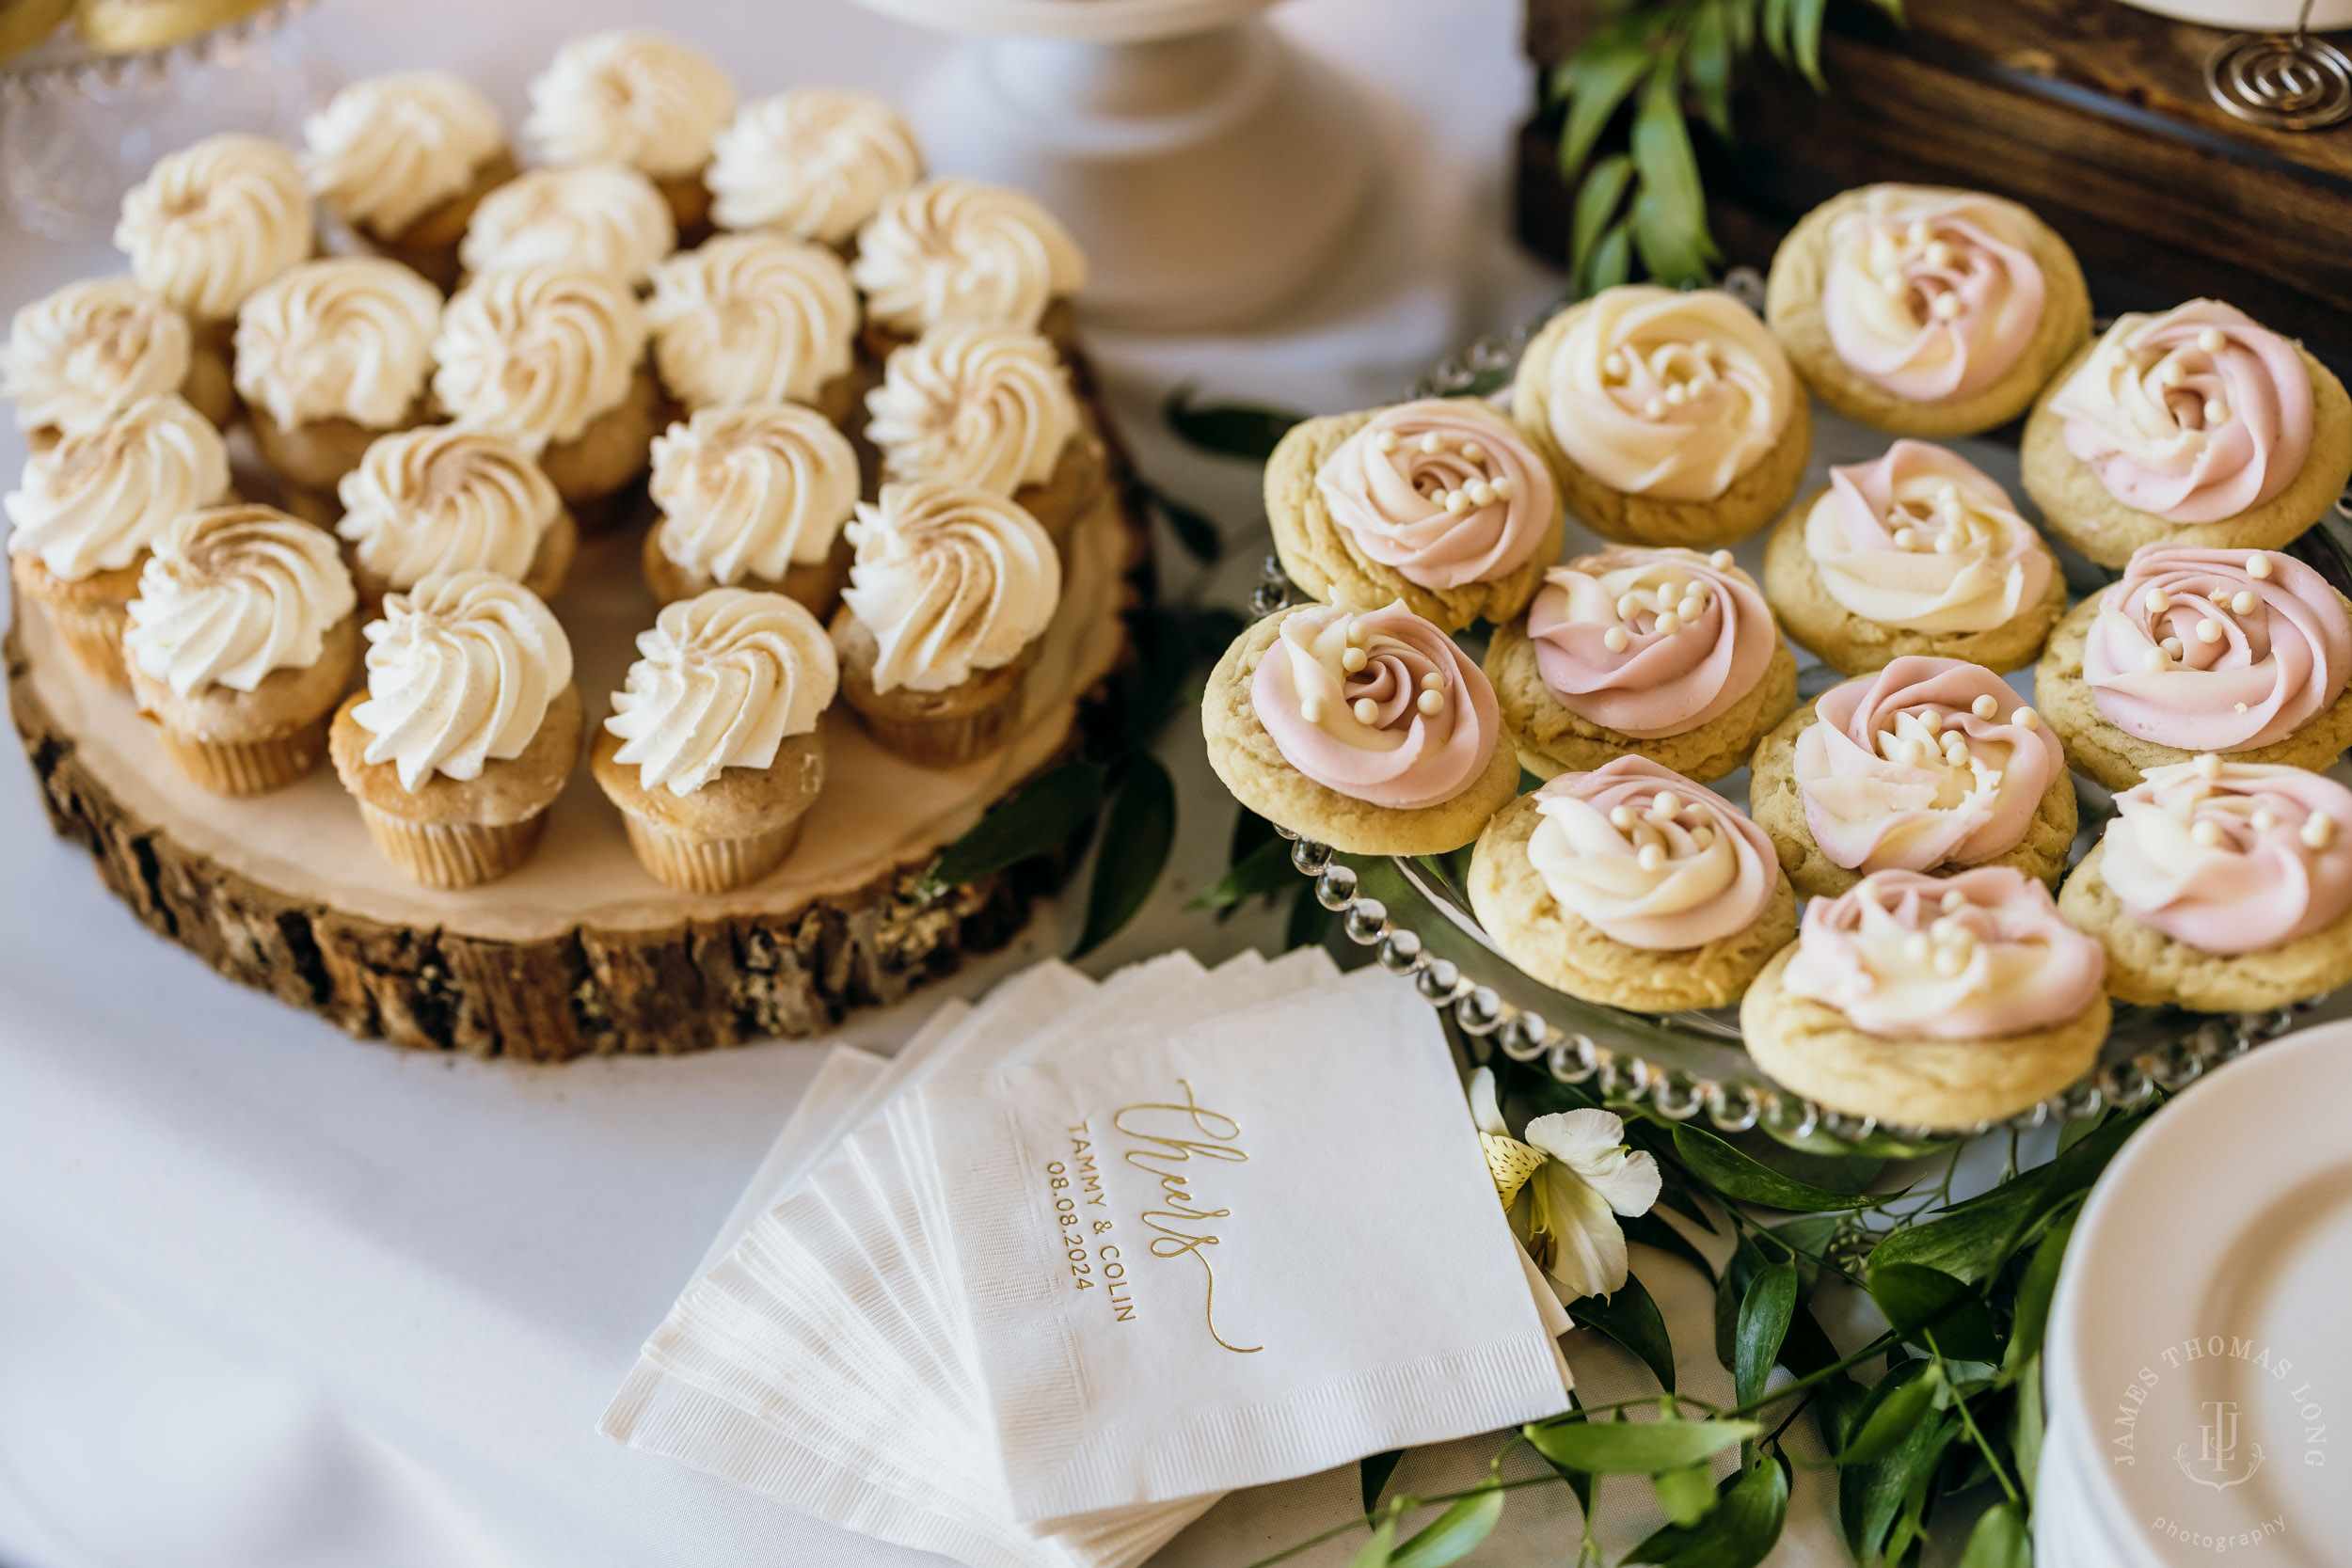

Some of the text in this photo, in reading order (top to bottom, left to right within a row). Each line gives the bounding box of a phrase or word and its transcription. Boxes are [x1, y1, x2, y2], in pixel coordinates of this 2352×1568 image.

[1046, 1161, 1095, 1291] 08.08.2024
[1068, 1122, 1136, 1323] TAMMY & COLIN
